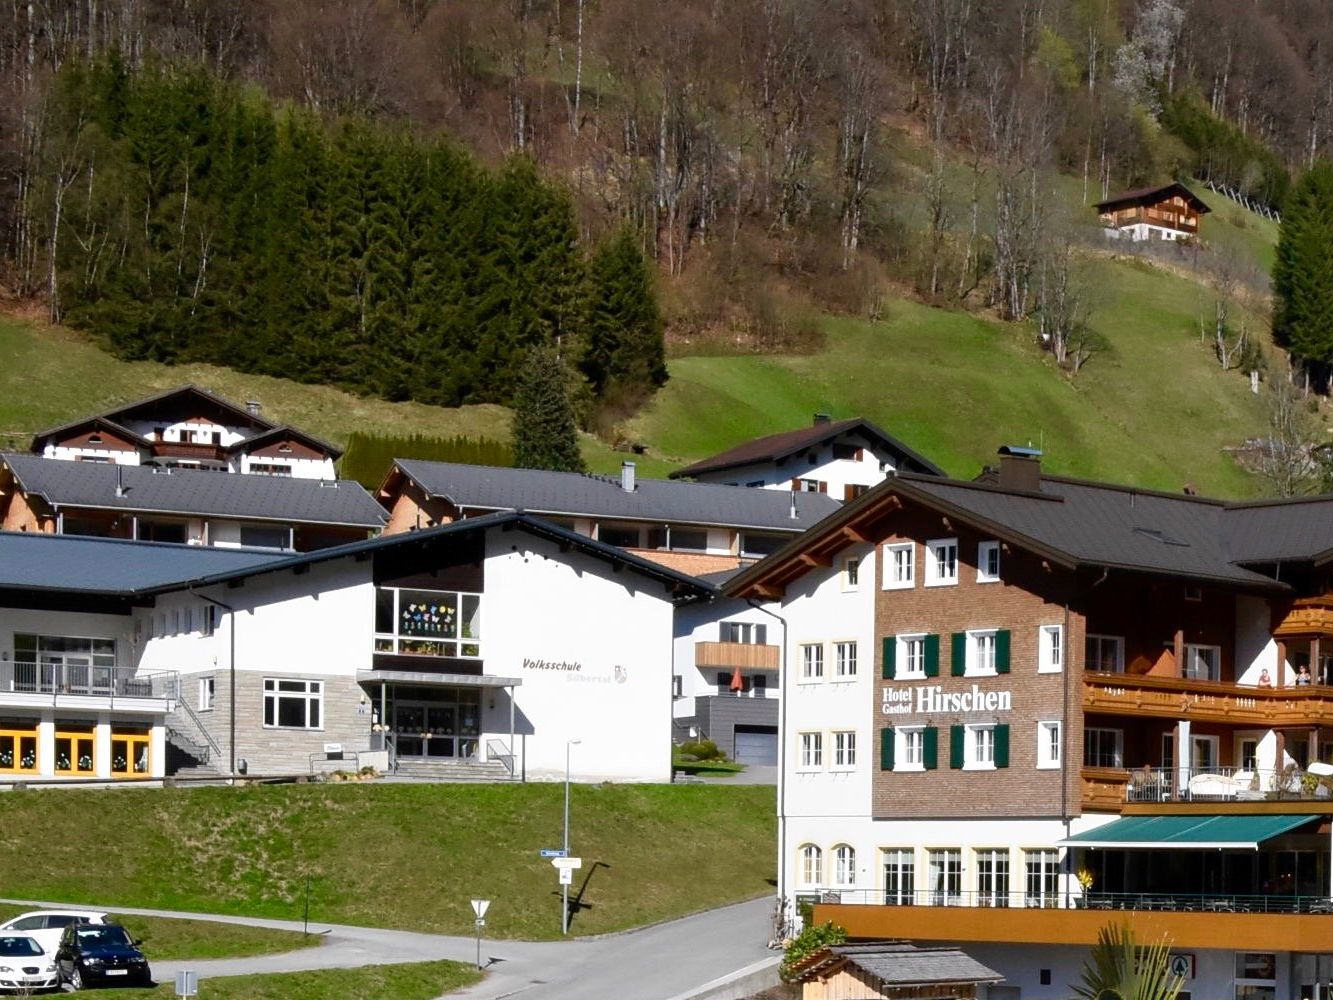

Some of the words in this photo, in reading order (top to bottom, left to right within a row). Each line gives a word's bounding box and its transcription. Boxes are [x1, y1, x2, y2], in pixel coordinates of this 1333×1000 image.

[522, 658, 582, 671] Volksschule
[882, 687, 912, 702] Hotel
[915, 684, 1012, 713] Hirschen
[882, 703, 912, 715] Gasthof
